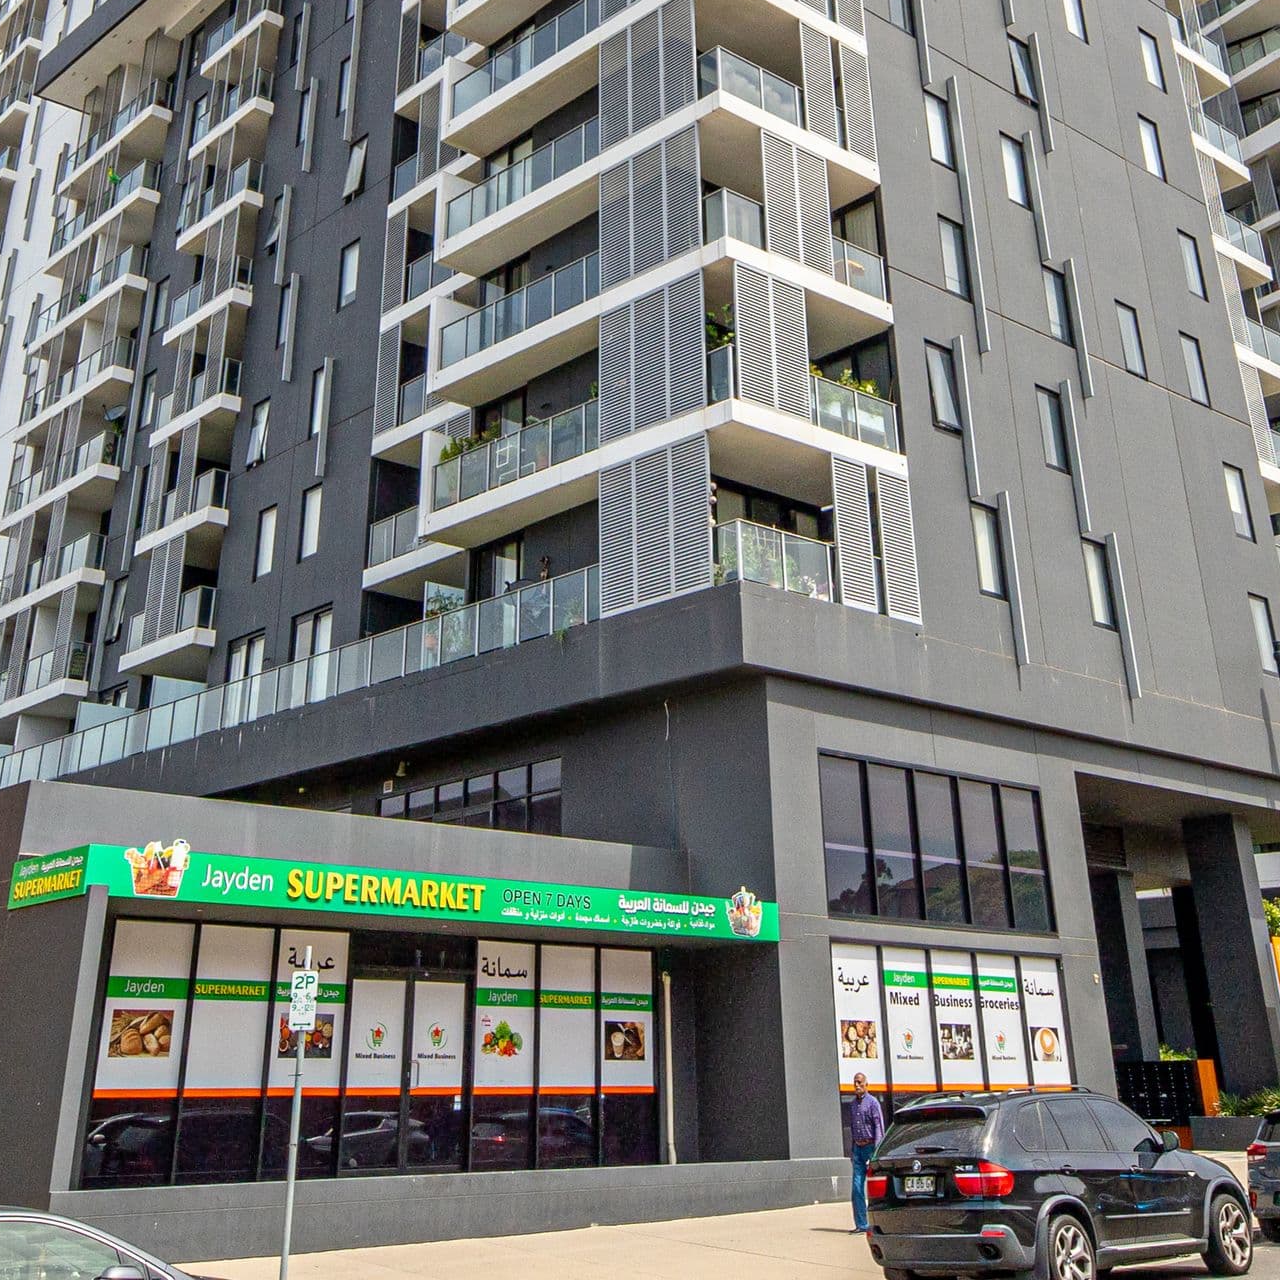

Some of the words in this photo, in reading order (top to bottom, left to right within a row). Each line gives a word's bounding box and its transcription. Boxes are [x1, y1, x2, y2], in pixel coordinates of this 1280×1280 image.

[13, 869, 83, 900] SUPERMARKET
[201, 864, 274, 896] Jayden
[287, 869, 486, 912] SUPERMARKET
[503, 889, 541, 905] OPEN
[545, 893, 553, 906] 7
[557, 894, 591, 910] DAYS
[618, 894, 651, 914] العربية
[652, 897, 689, 914] للسمانة
[691, 901, 716, 918] جيدن
[481, 956, 528, 978] سمانة
[124, 979, 165, 996] Jayden
[195, 983, 266, 996] SUPERMARKET
[295, 975, 316, 989] 2P
[838, 966, 869, 993] عربية
[893, 972, 915, 985] Jayden
[488, 989, 518, 1004] Jayden
[539, 994, 592, 1005] SUPERMARKET
[890, 992, 920, 1006] Mixed
[935, 994, 973, 1008] Business
[980, 996, 1019, 1010] Groceries
